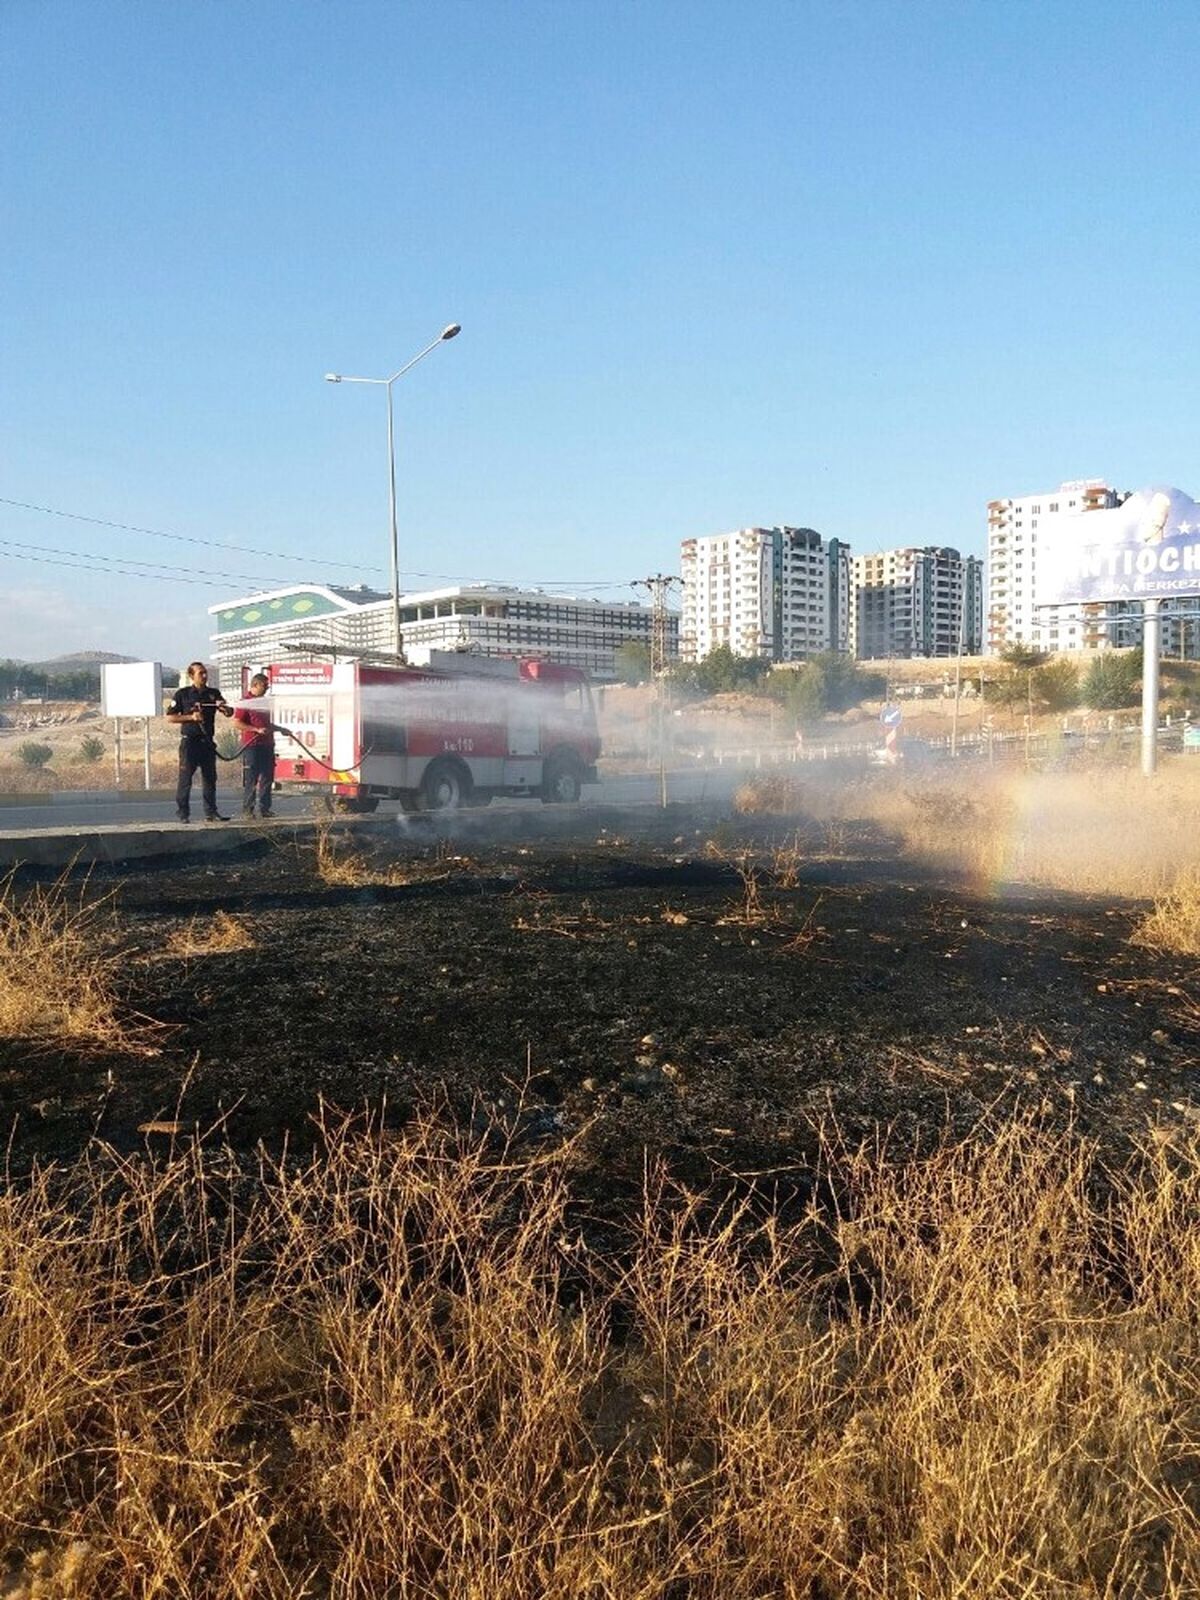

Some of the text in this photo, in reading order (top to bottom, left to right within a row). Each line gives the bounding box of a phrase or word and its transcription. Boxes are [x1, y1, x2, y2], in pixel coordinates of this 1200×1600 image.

[1070, 544, 1200, 578] NTIOCH
[279, 706, 324, 724] İTFAİYE
[287, 730, 316, 748] 110
